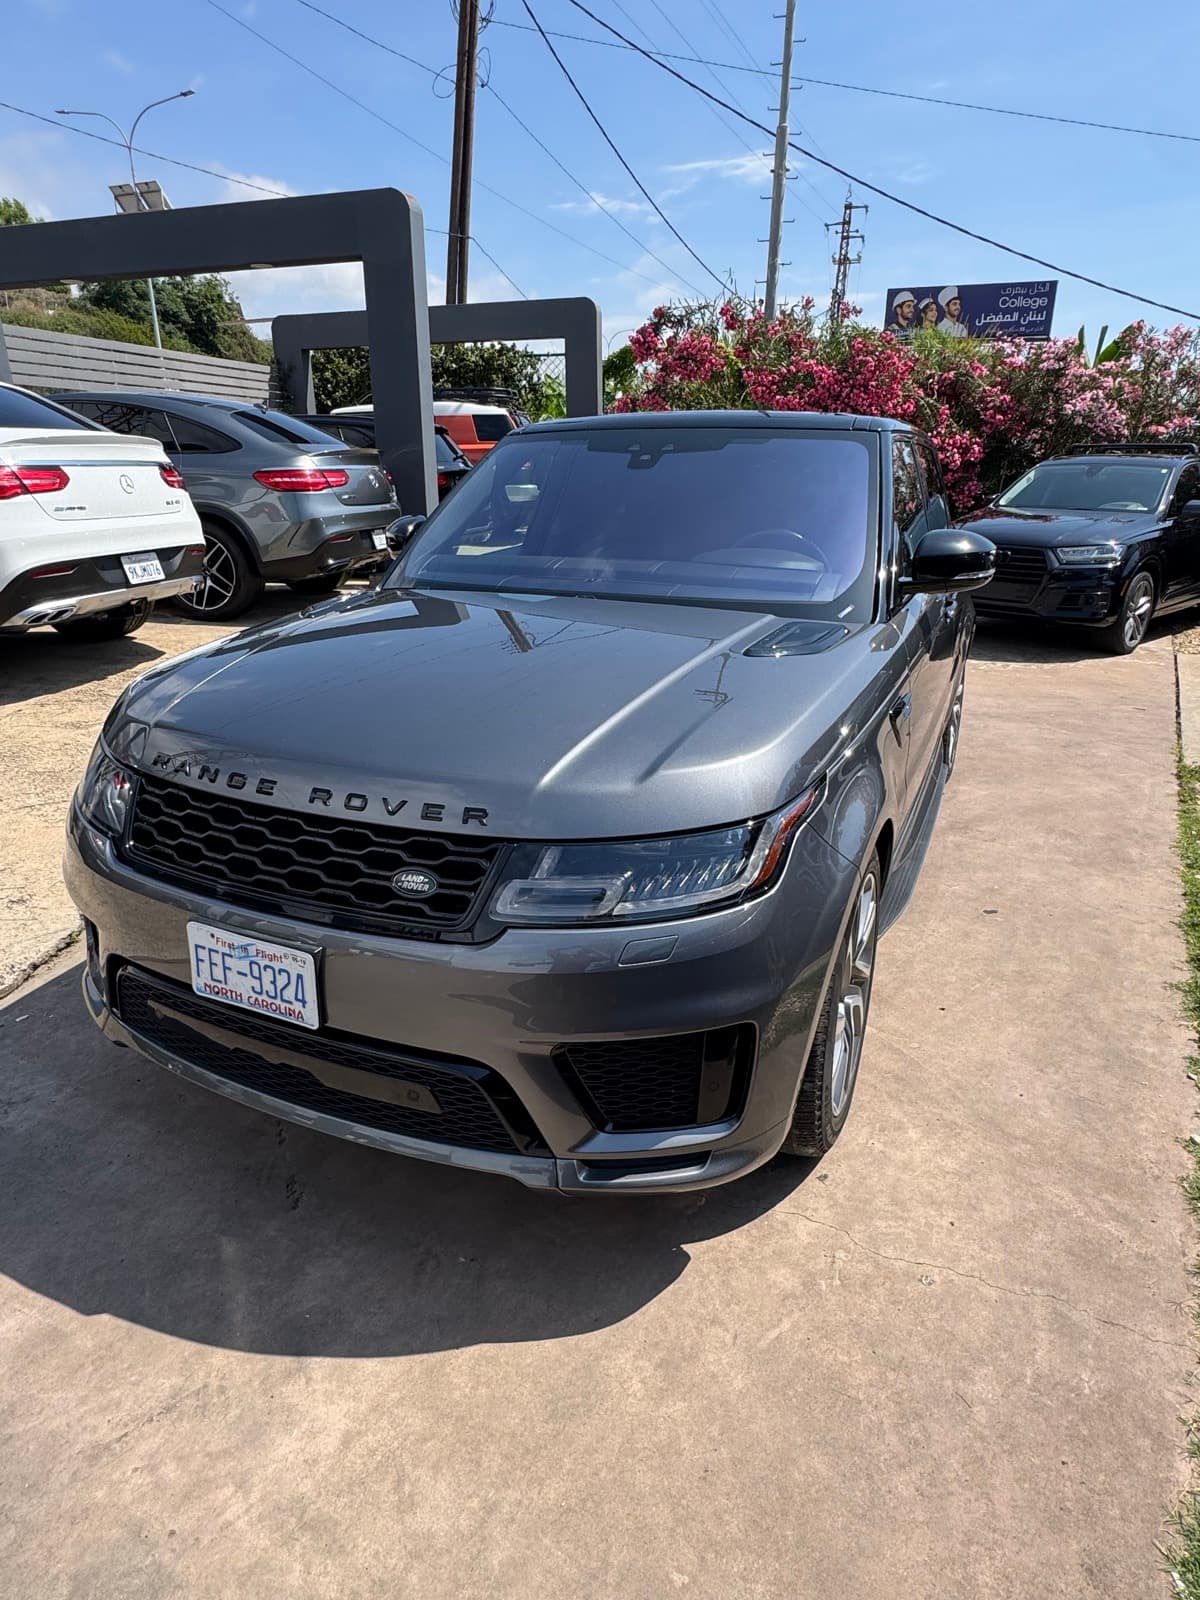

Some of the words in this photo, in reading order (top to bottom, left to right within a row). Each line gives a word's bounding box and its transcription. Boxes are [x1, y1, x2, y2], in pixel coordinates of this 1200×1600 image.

[1029, 283, 1050, 295] الكل
[999, 296, 1048, 309] College
[975, 311, 1019, 326] المفضل
[1021, 311, 1047, 325] لبنان
[151, 752, 278, 797] RANGE
[308, 787, 489, 827] ROVER
[215, 936, 236, 951] First
[255, 948, 284, 964] Flight
[194, 943, 308, 1009] FEF-9324
[203, 982, 243, 1003] NORTH
[247, 995, 305, 1021] CAROLINA
